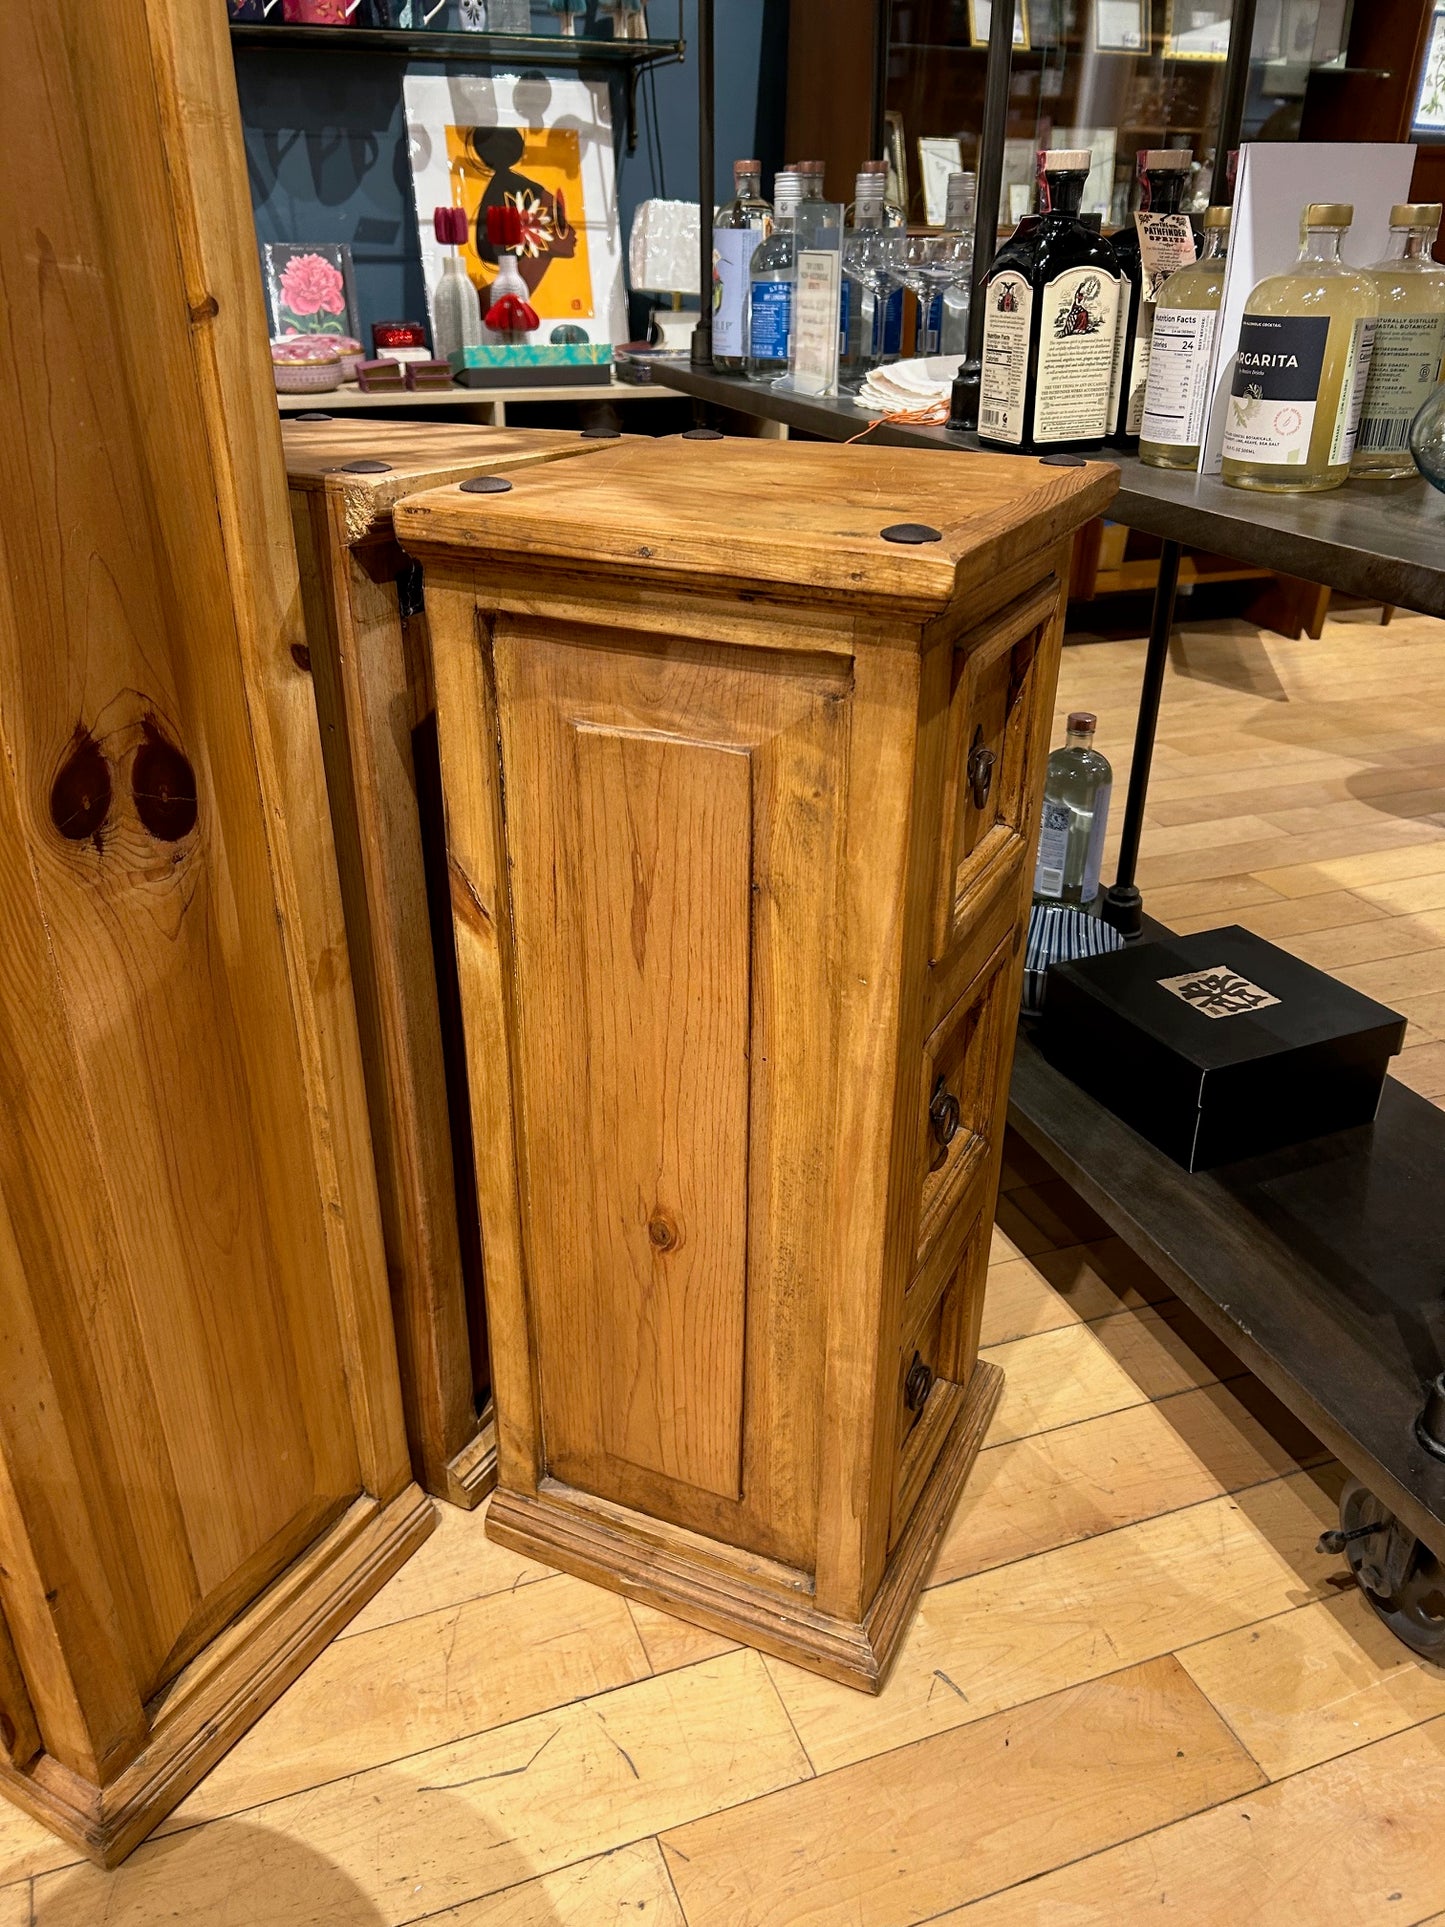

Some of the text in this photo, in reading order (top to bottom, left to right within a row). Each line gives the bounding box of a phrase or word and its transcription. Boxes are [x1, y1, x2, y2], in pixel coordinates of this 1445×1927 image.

[1144, 226, 1187, 237] PATHFINDER
[769, 284, 791, 293] LYRE'
[1177, 316, 1196, 324] Facts
[1182, 340, 1194, 350] 24
[1238, 352, 1298, 368] RGARITA
